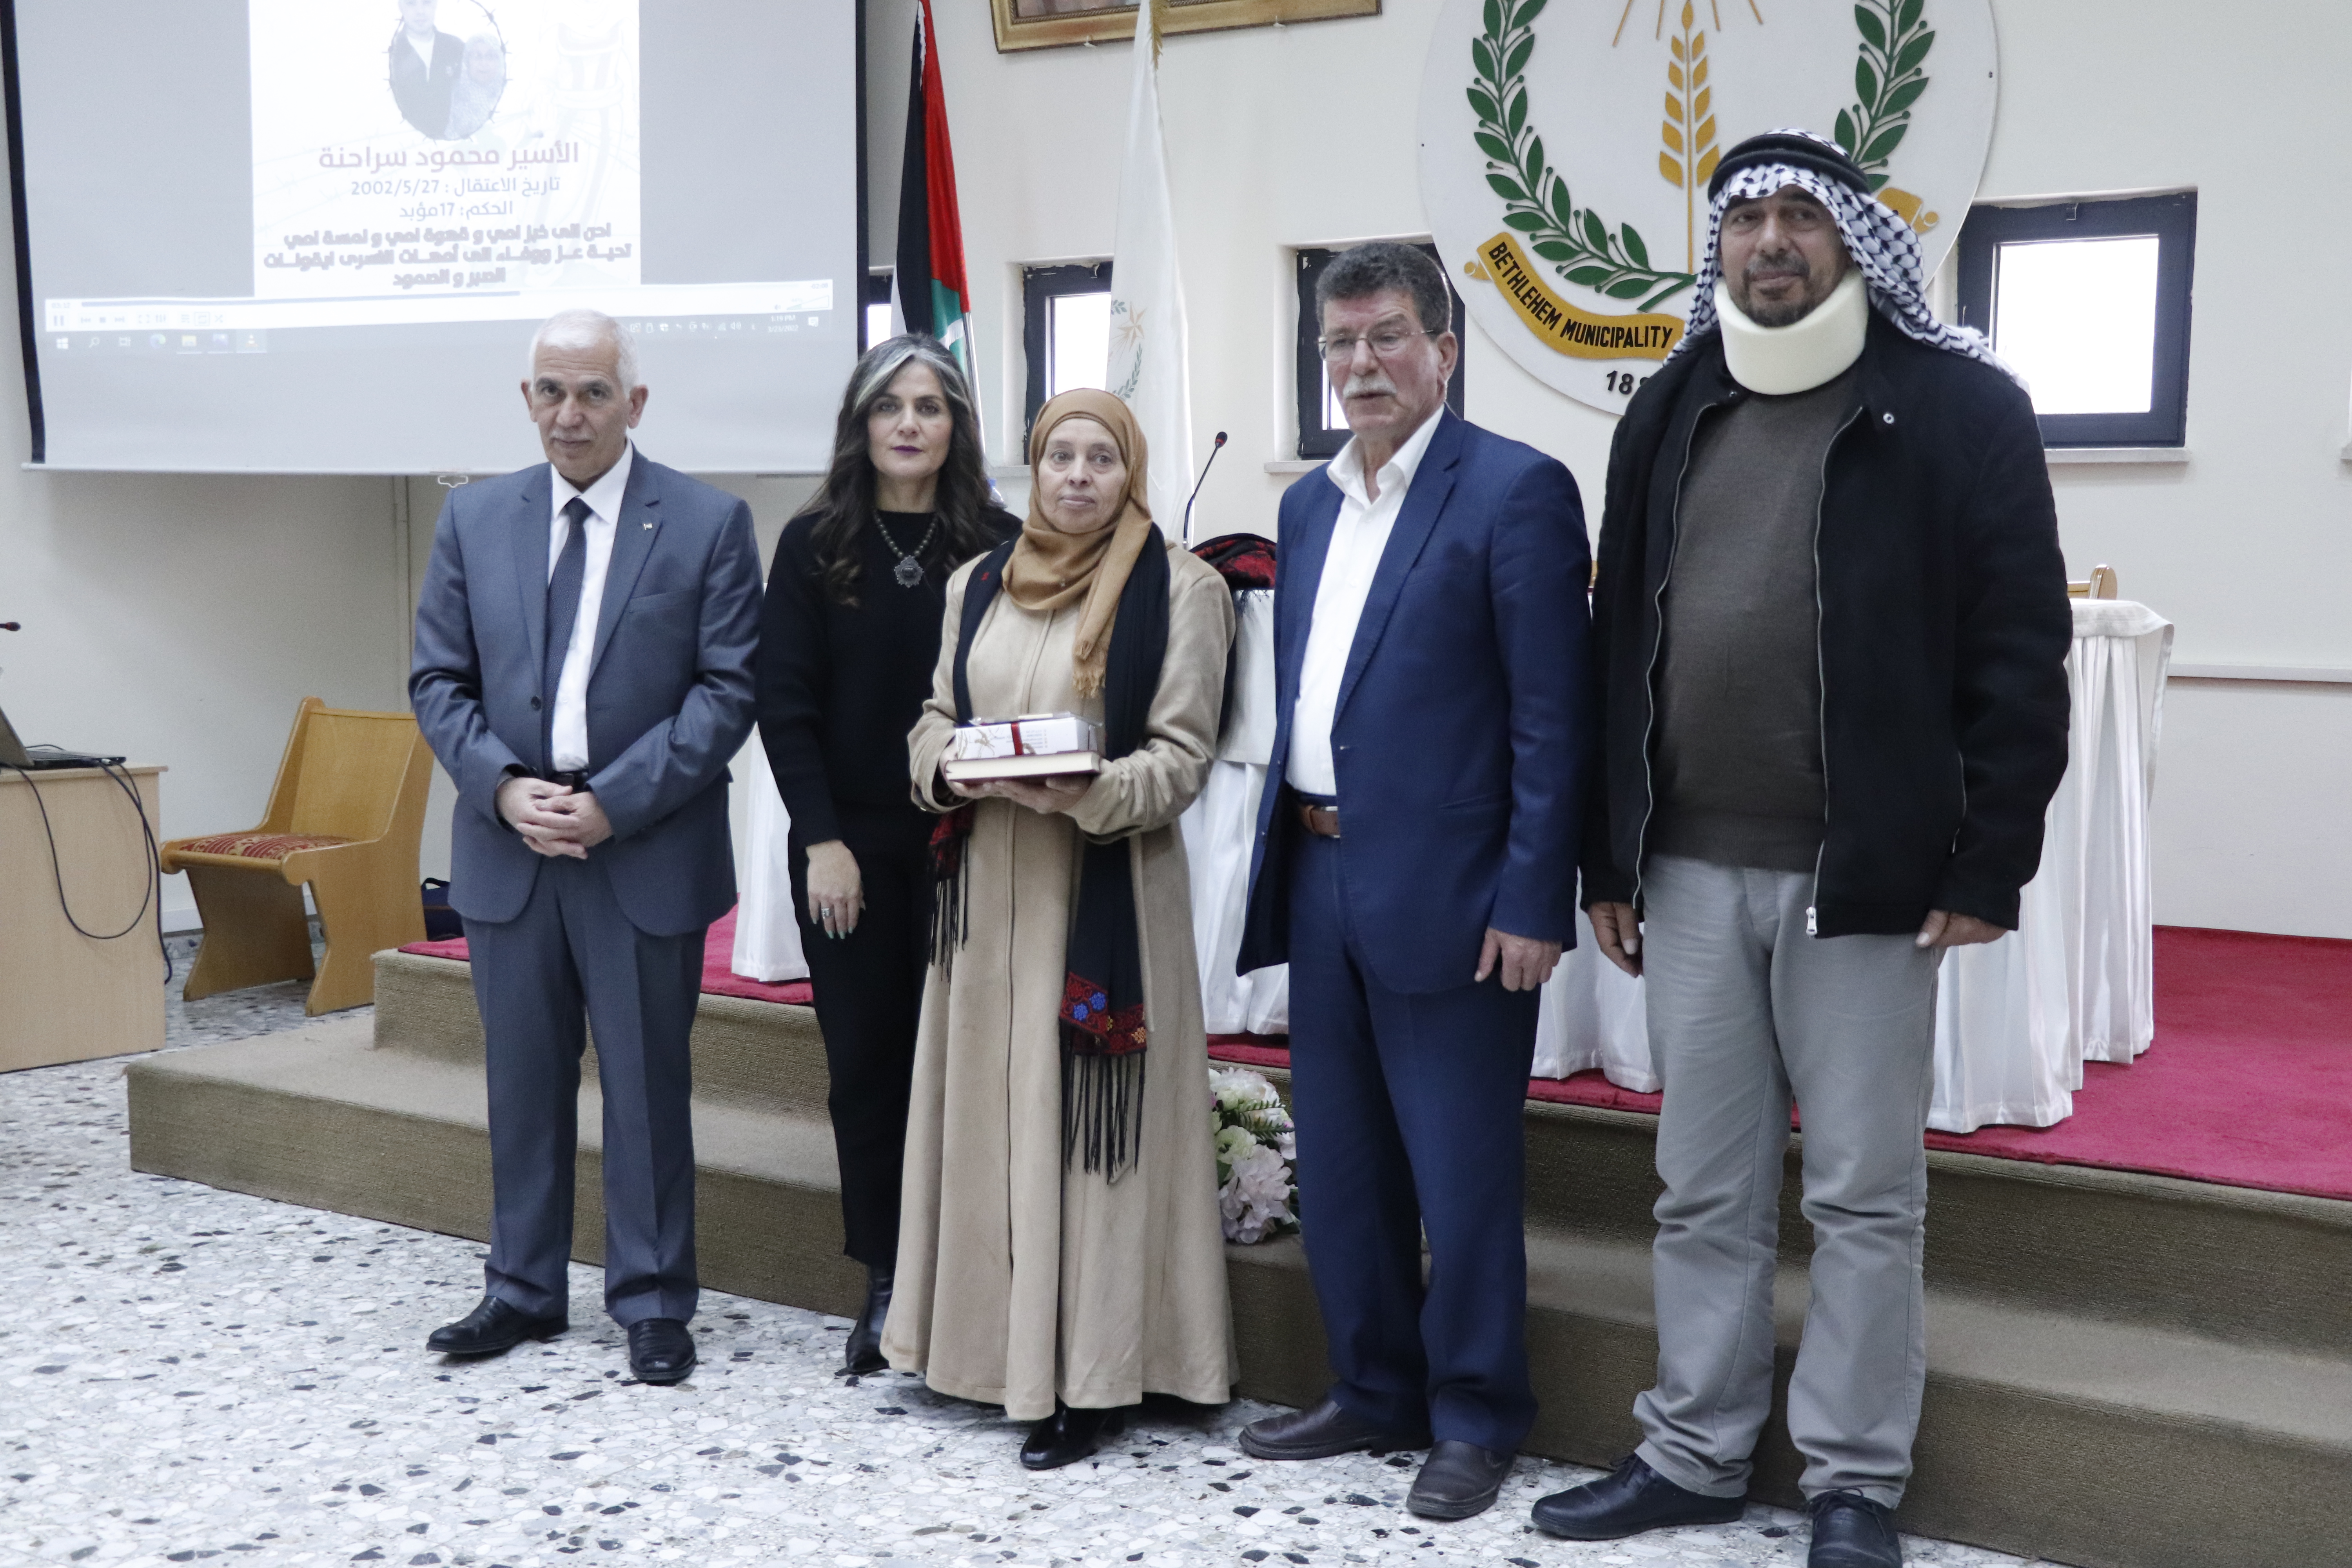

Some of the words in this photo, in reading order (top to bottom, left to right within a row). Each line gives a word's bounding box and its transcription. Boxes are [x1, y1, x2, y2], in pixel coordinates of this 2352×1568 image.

[319, 147, 407, 174] سراحنة
[415, 149, 501, 173] محمود
[506, 139, 579, 171] الأسير
[351, 179, 439, 198] 2002/5/27
[454, 178, 517, 198] الاعتقال
[521, 176, 561, 198] تاريخ
[322, 228, 369, 246] لمسة
[370, 232, 383, 249] و
[423, 226, 470, 247] قهوة
[472, 229, 484, 246] و
[523, 223, 549, 245] خبز
[392, 268, 450, 290] الصمود
[452, 272, 465, 289] و
[465, 267, 507, 289] الصبر
[1488, 241, 1563, 331] BETHLEHEM
[1560, 318, 1673, 349] MUNICIPALITY
